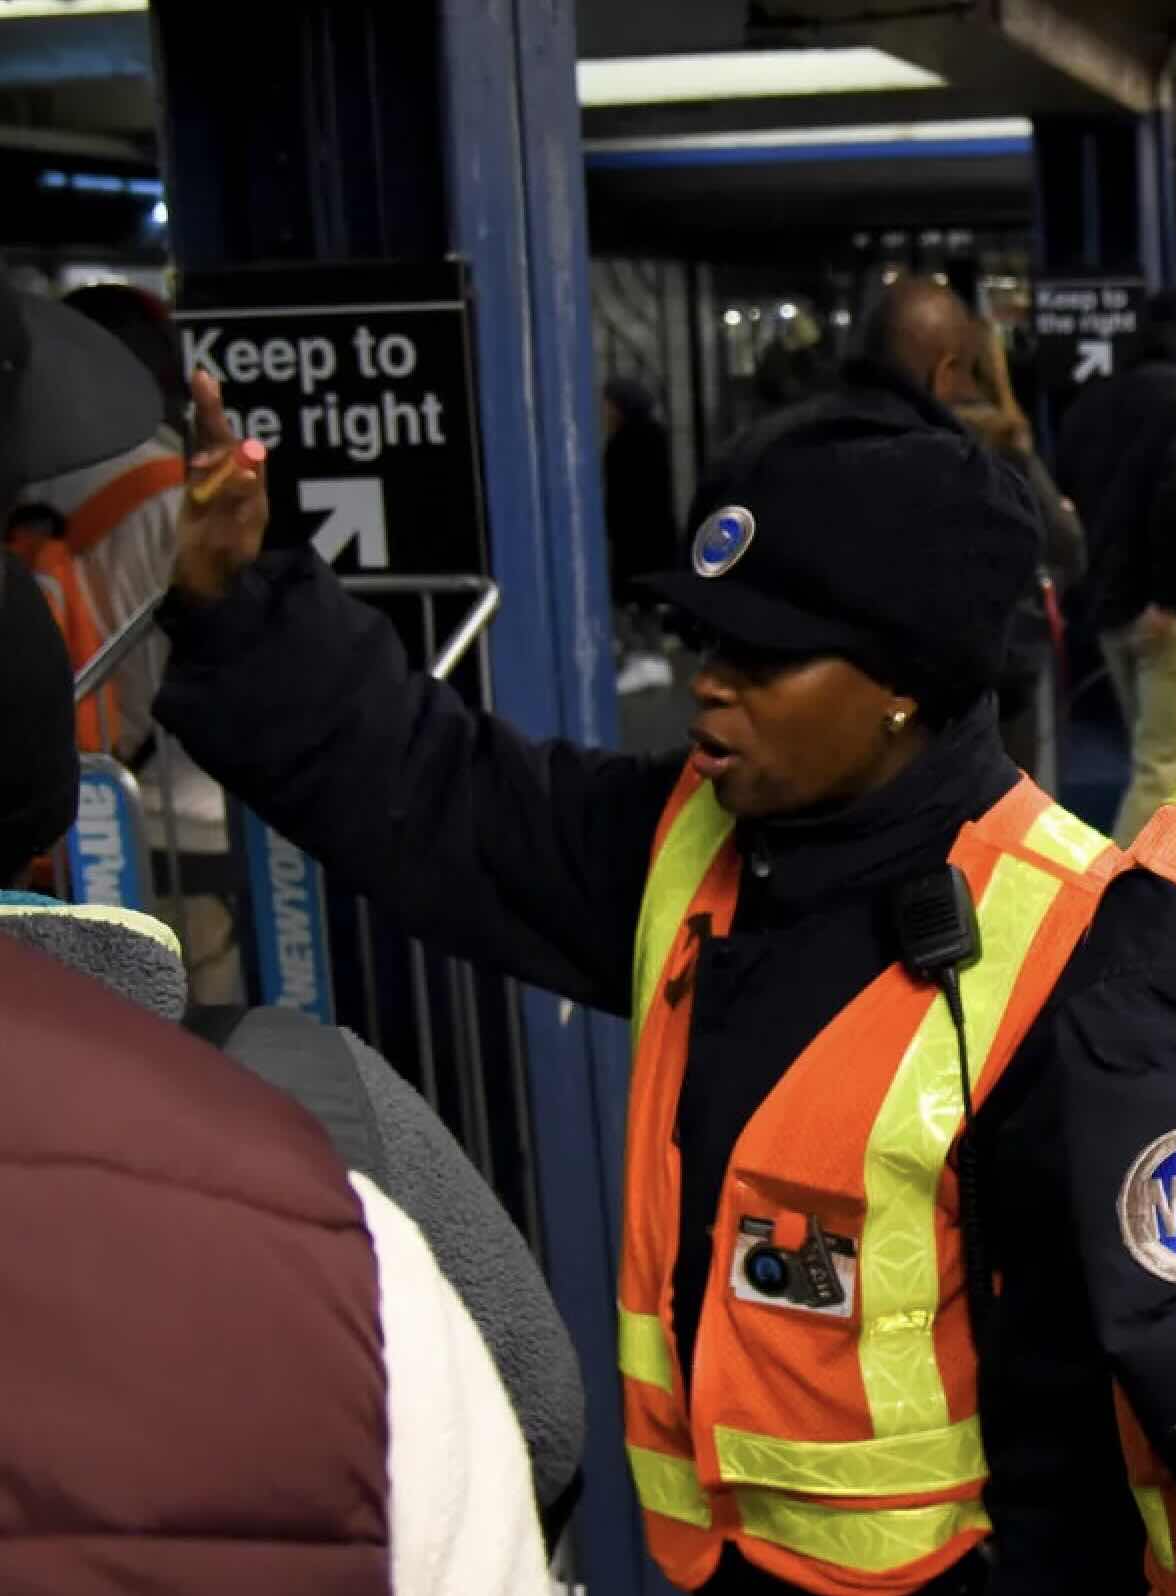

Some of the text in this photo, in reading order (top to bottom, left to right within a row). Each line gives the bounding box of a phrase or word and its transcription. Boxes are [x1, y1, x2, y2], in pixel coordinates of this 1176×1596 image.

[1036, 284, 1128, 313] Keep to
[1037, 310, 1137, 339] the right
[181, 325, 418, 394] Keep to
[300, 391, 446, 461] right
